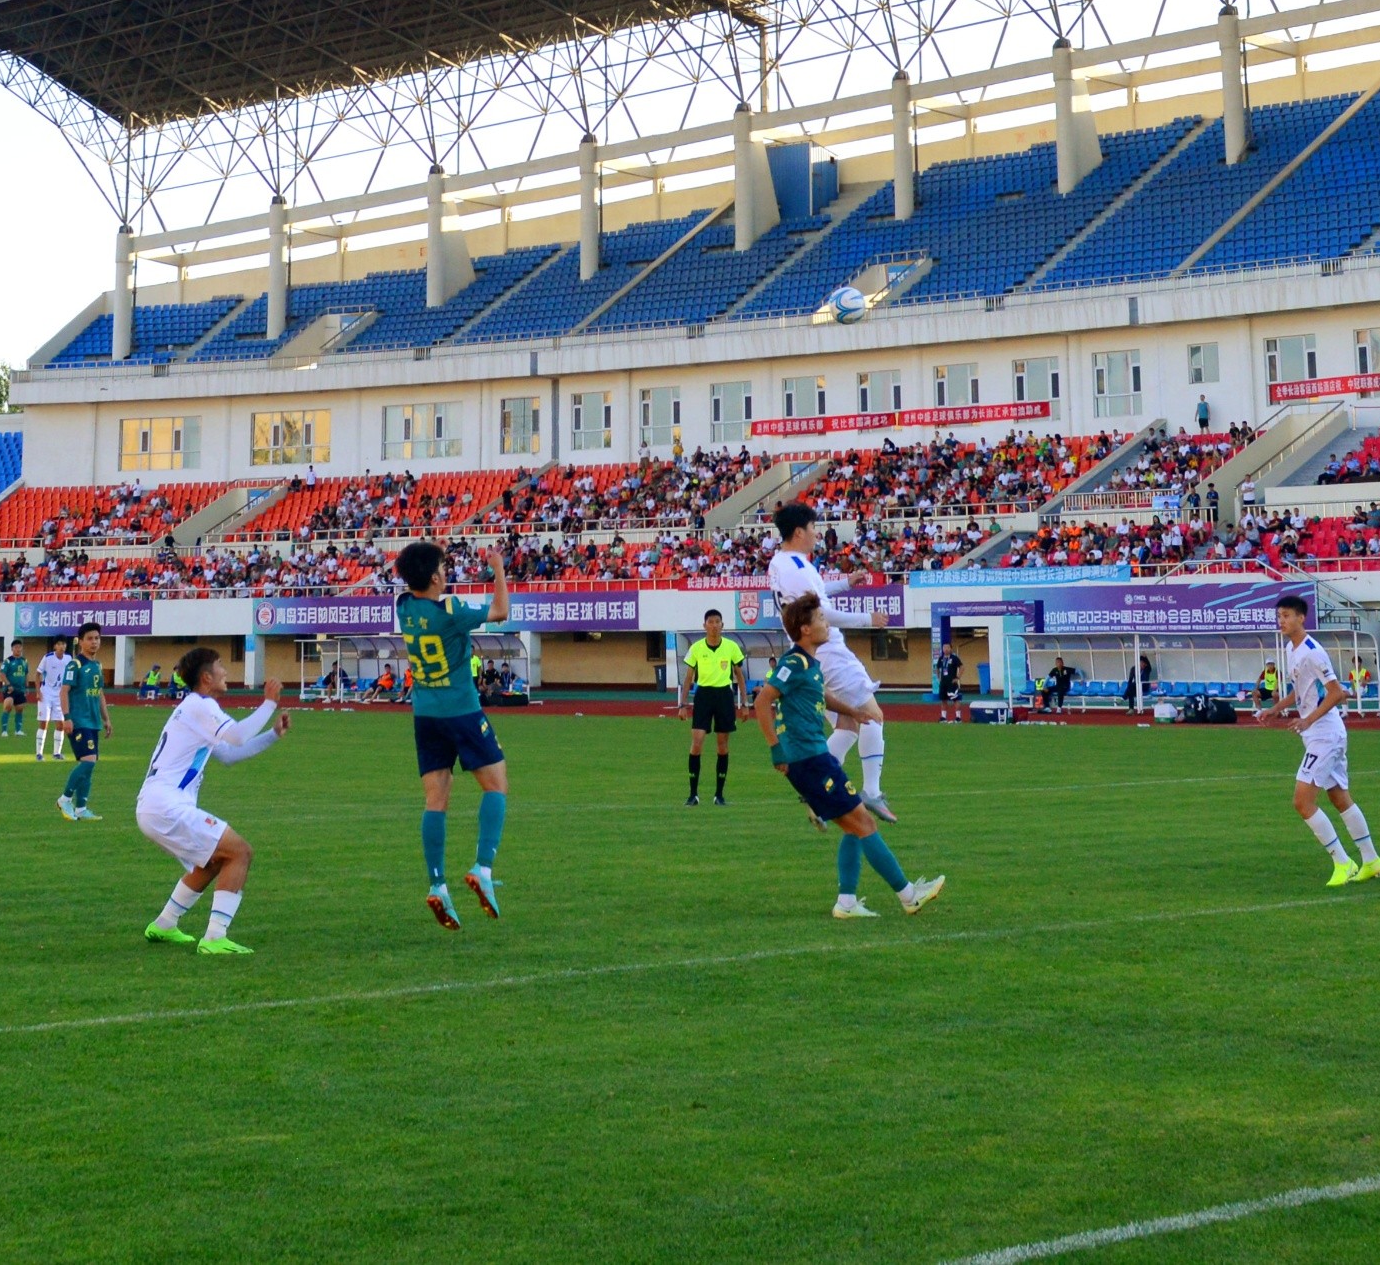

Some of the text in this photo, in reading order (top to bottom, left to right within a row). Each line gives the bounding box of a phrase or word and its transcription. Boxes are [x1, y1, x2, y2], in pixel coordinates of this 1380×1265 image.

[276, 606, 392, 624] 青岛五月的风足球俱乐部
[511, 601, 636, 622] 西安荣海足球俱乐部
[1303, 752, 1318, 769] 17
